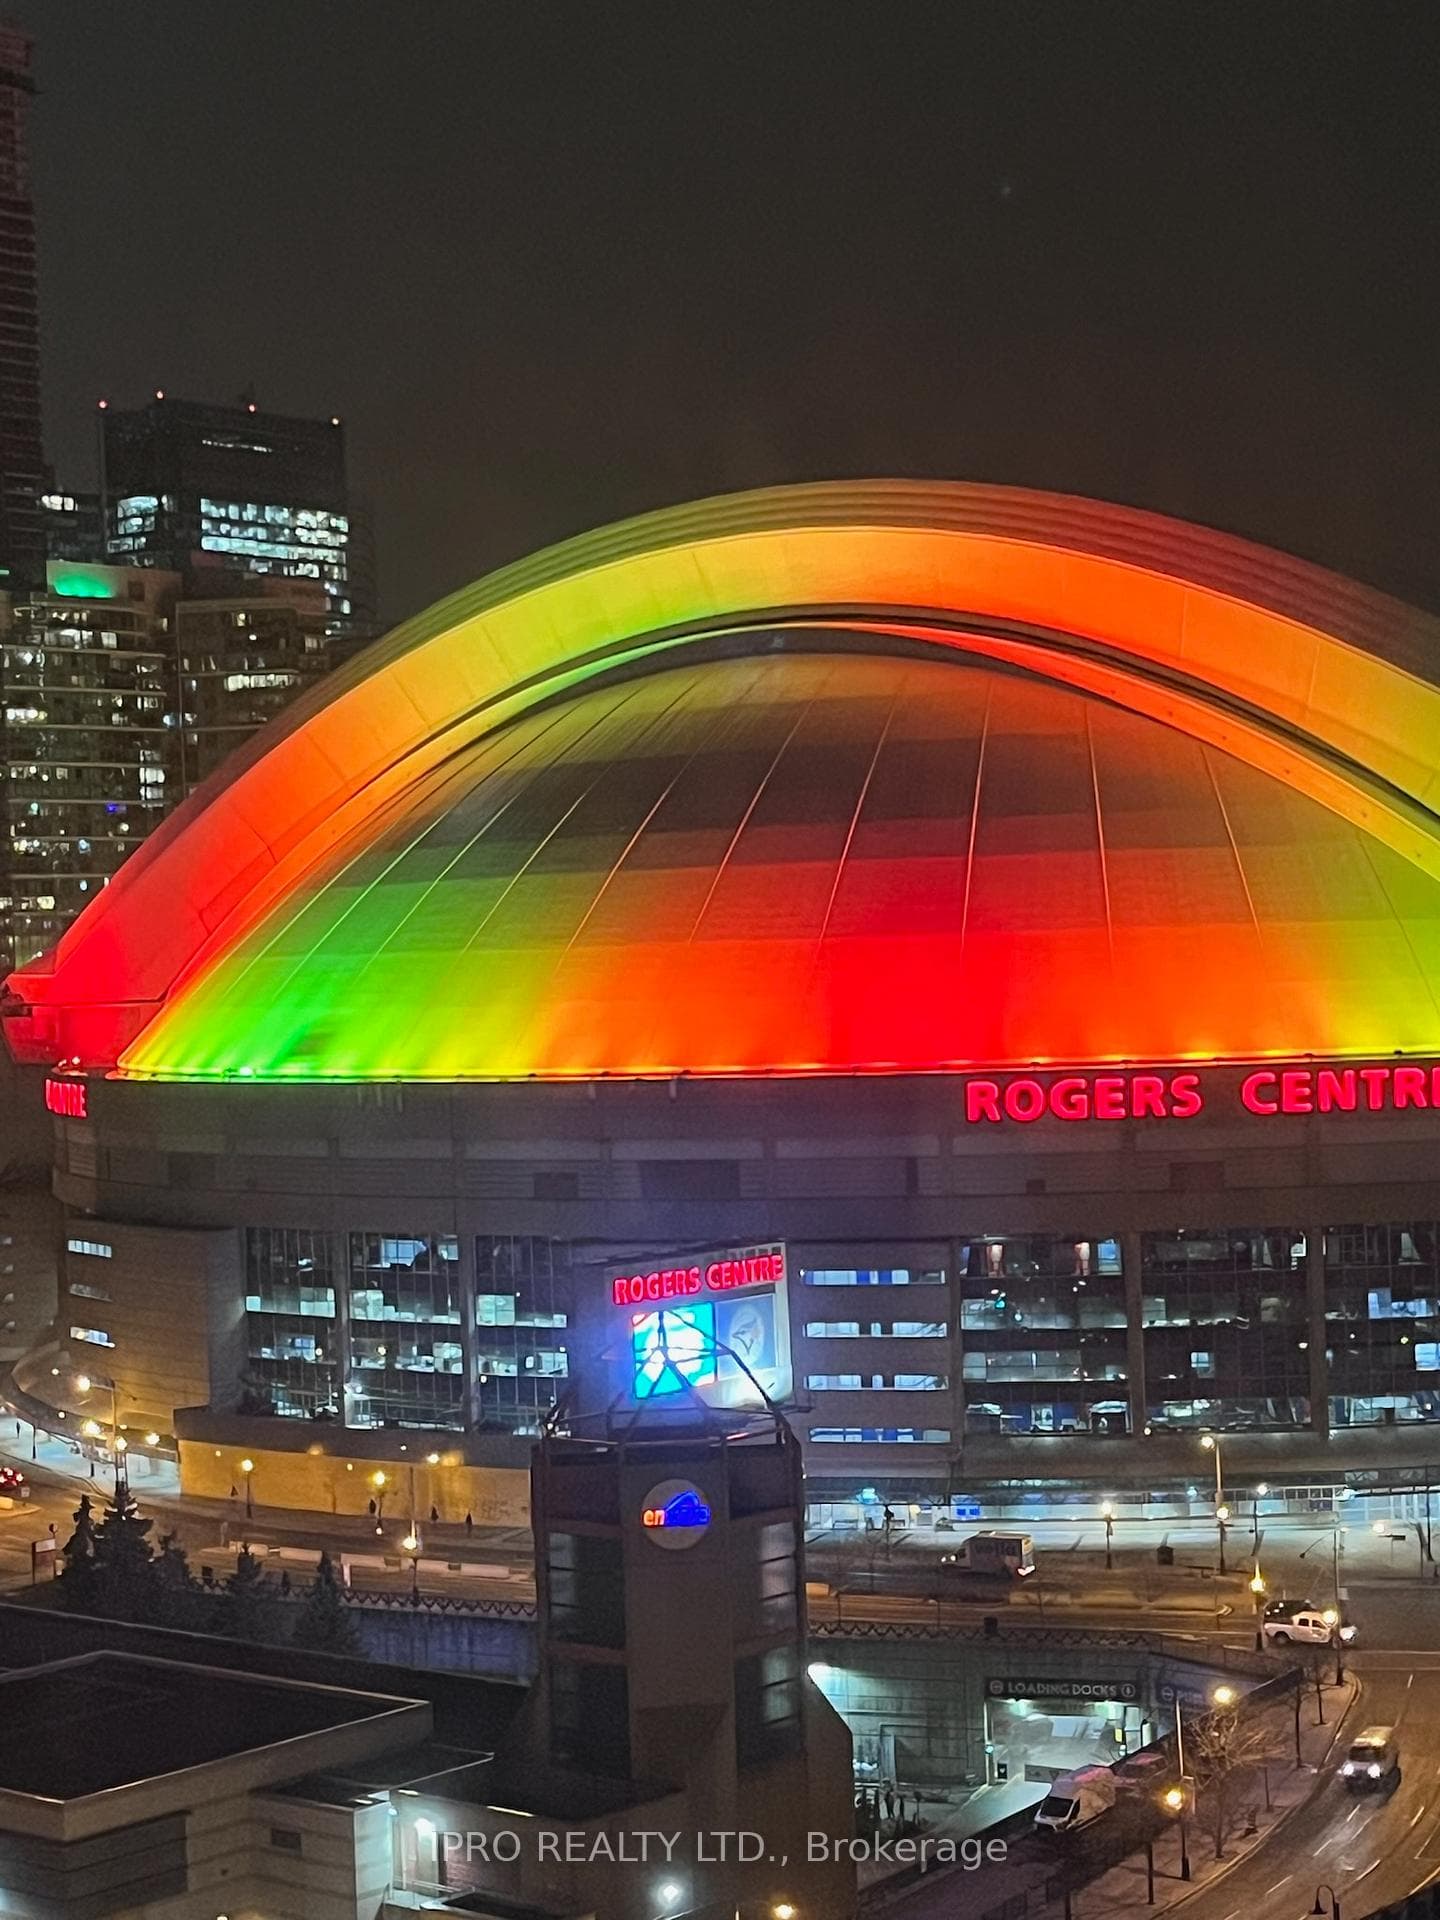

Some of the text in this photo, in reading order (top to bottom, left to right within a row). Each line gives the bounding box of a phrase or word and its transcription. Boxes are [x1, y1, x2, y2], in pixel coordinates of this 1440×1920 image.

[967, 1067, 1440, 1121] ROGERS CENTR
[614, 1255, 784, 1304] ROGERS CENTRE
[1007, 1682, 1117, 1697] LOADING DOCKS
